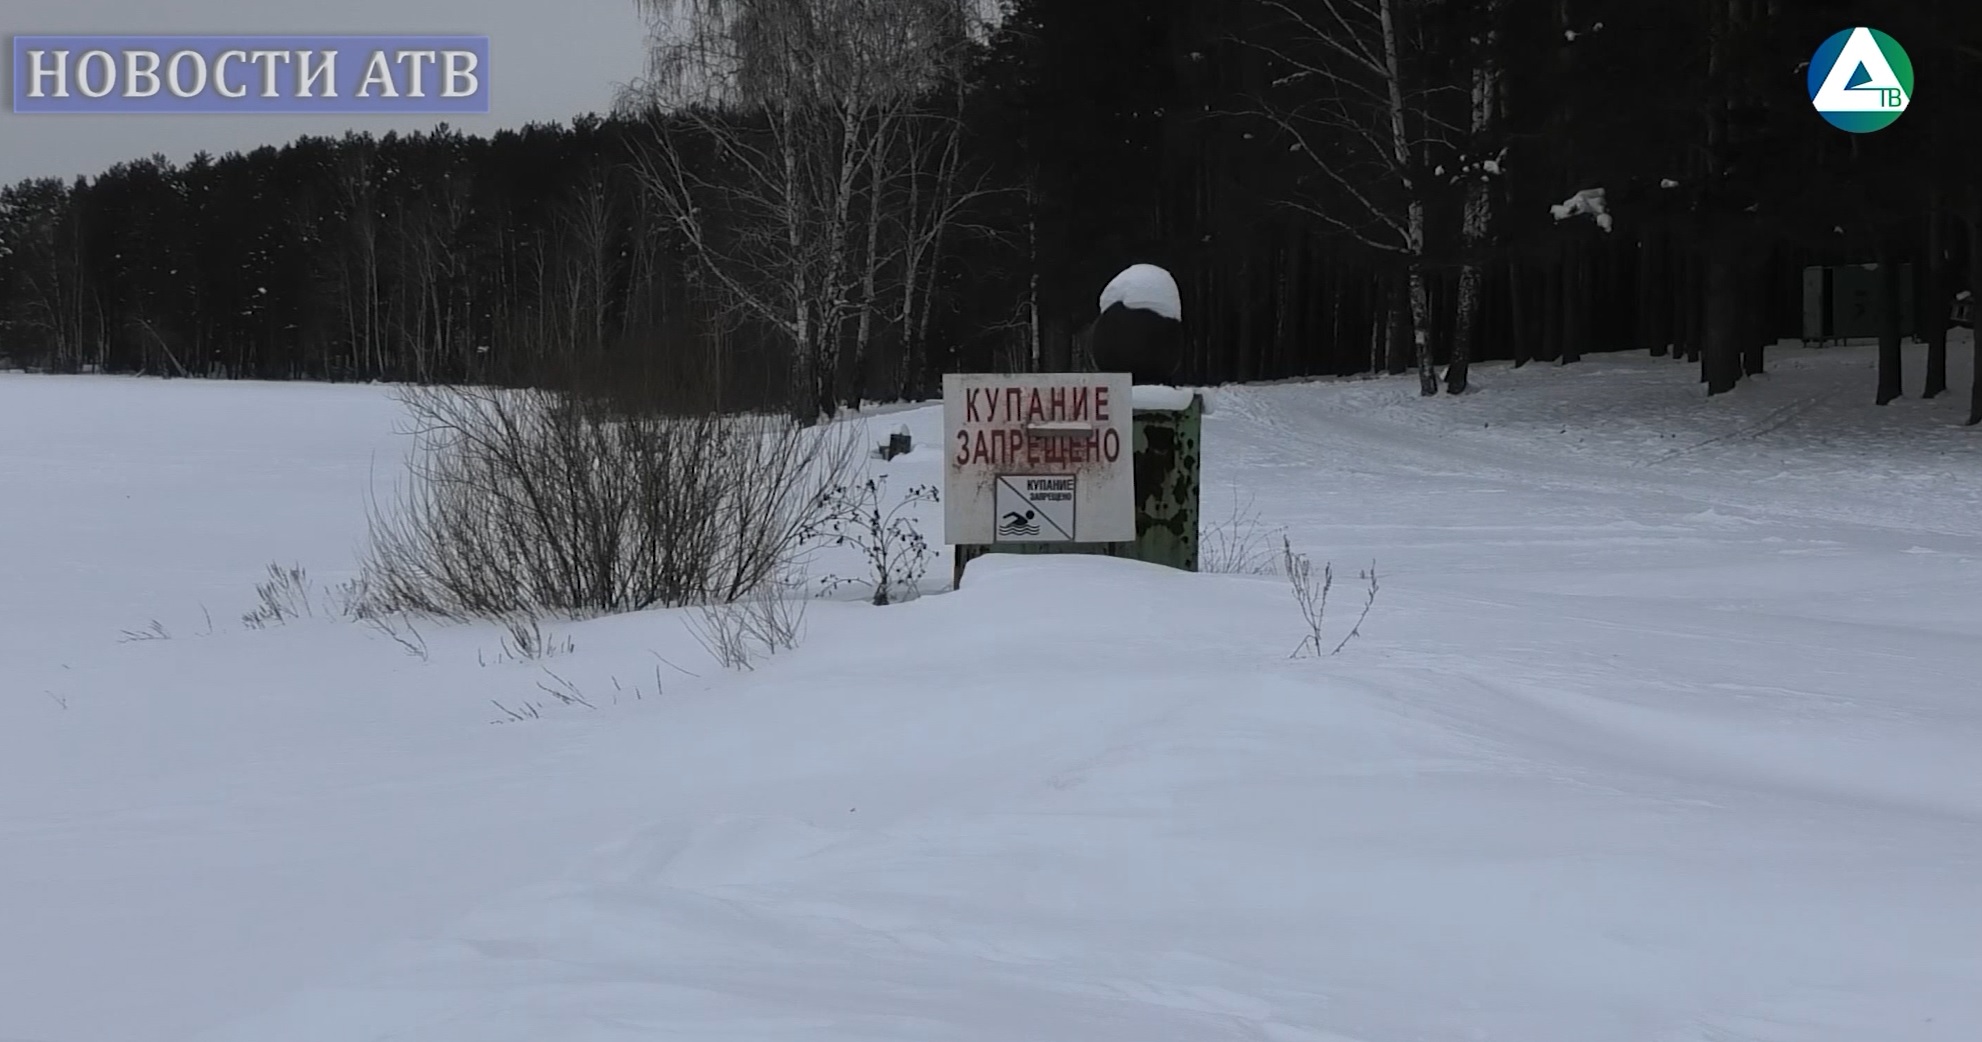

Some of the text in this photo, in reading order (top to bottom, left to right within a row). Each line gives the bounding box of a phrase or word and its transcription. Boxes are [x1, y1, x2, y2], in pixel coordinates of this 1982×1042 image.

[966, 386, 1109, 422] КУПАНИЕ
[956, 428, 1120, 469] ЗАПРЕЩЕНО
[1027, 479, 1074, 491] КУПАНИЕ
[1029, 492, 1072, 501] ЗАПРЕЩЕНО
